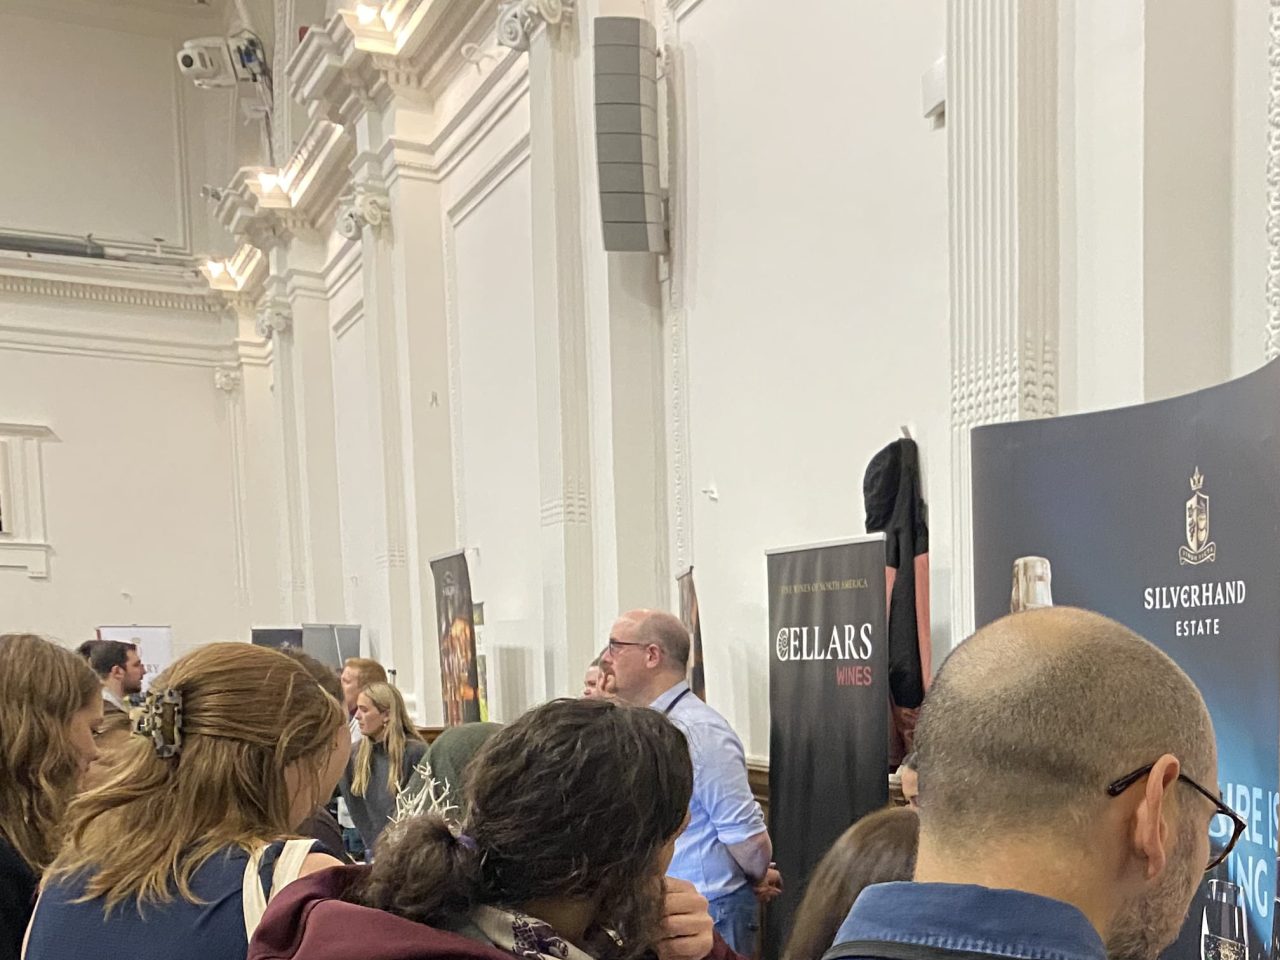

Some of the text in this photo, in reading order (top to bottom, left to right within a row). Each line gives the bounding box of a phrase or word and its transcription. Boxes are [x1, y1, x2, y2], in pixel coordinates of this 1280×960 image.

[1144, 580, 1246, 610] SILVERHAND
[1175, 618, 1220, 637] ESTATE
[776, 622, 873, 662] CELLARS
[836, 665, 872, 686] WINES
